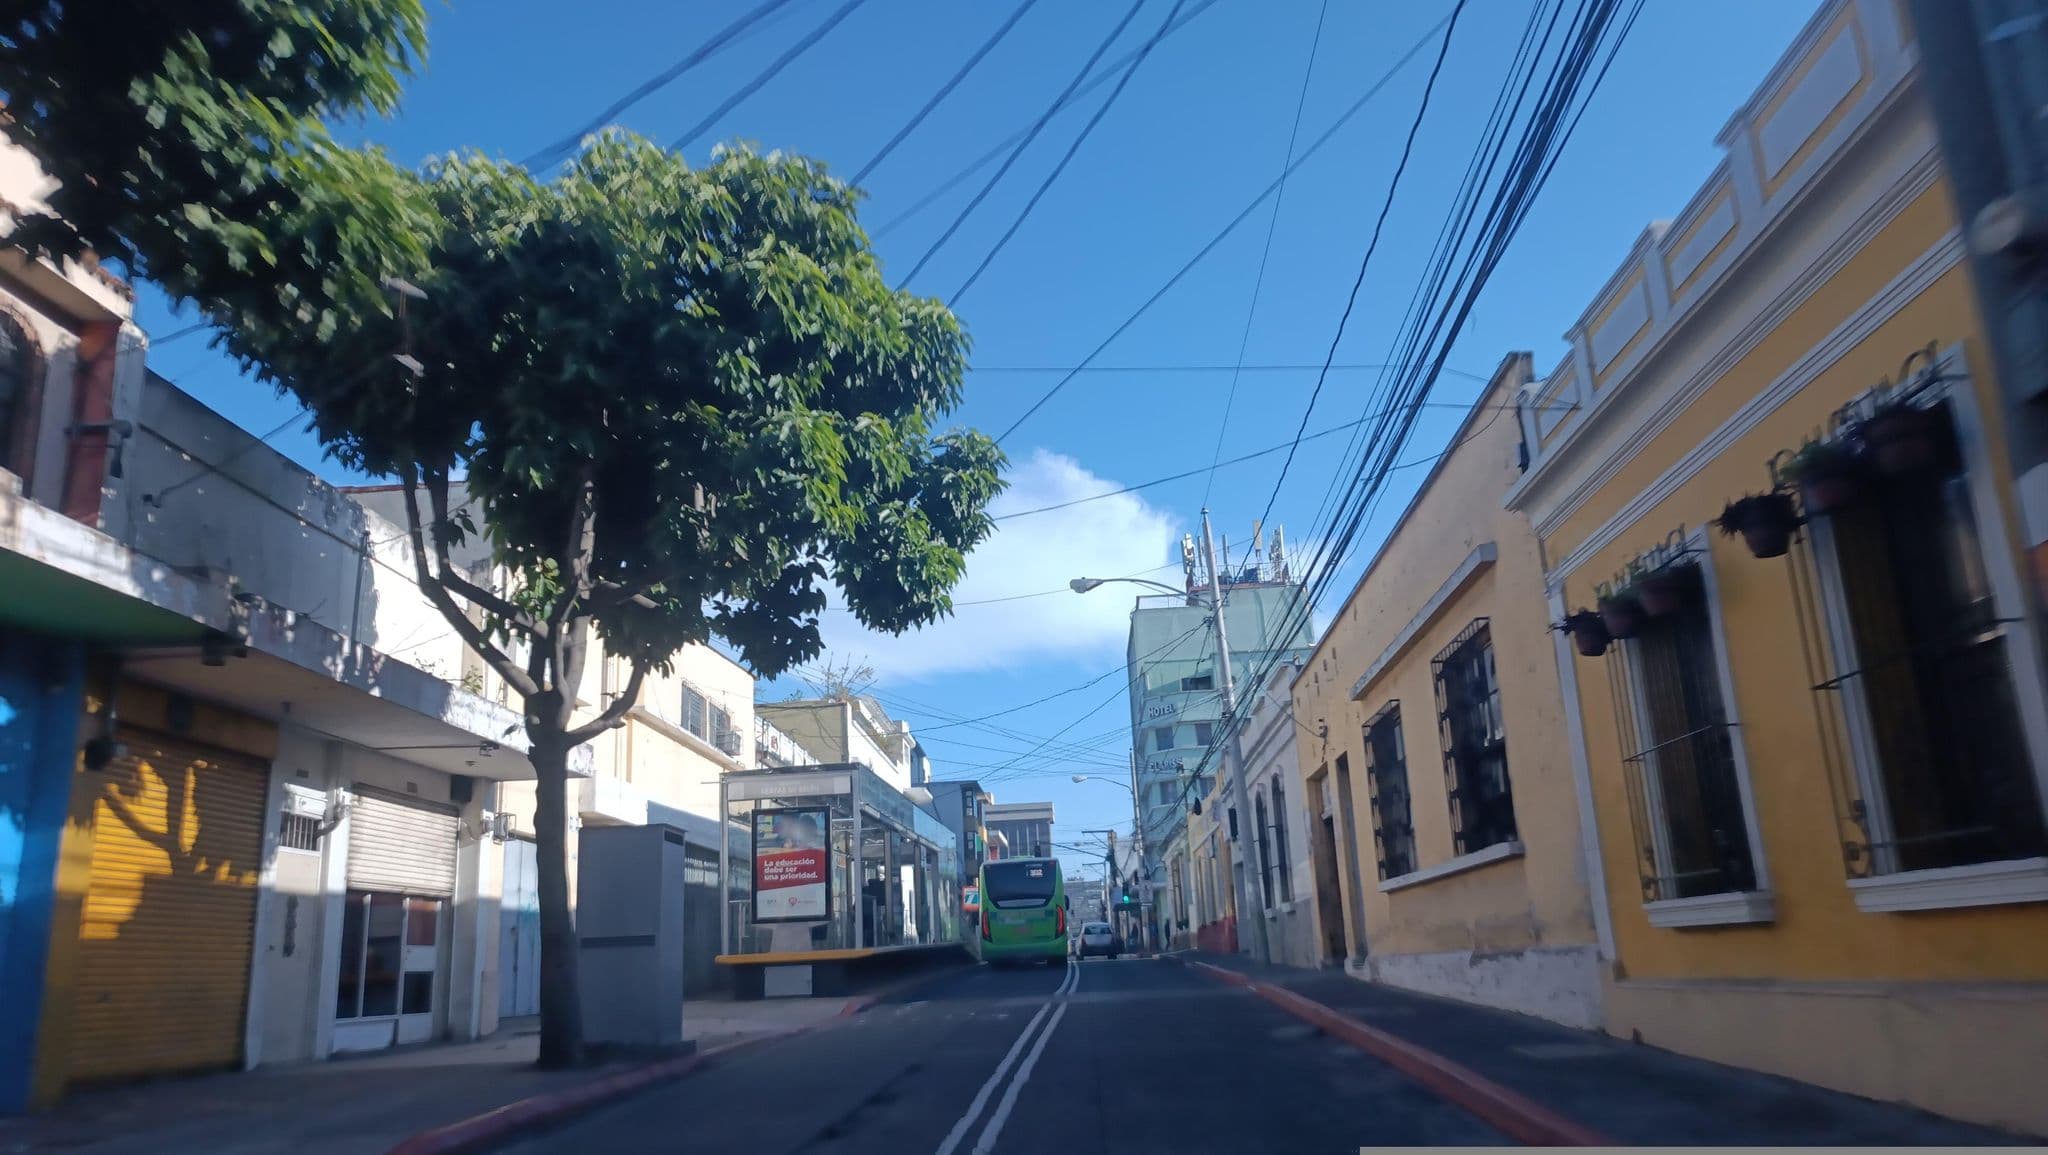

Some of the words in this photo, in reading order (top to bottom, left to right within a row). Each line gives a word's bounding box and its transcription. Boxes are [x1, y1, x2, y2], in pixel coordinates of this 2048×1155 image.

[1148, 704, 1175, 718] HOTEL
[764, 860, 774, 868] La
[775, 858, 815, 868] educación
[764, 866, 784, 874] debe
[780, 872, 818, 882] prioridad.
